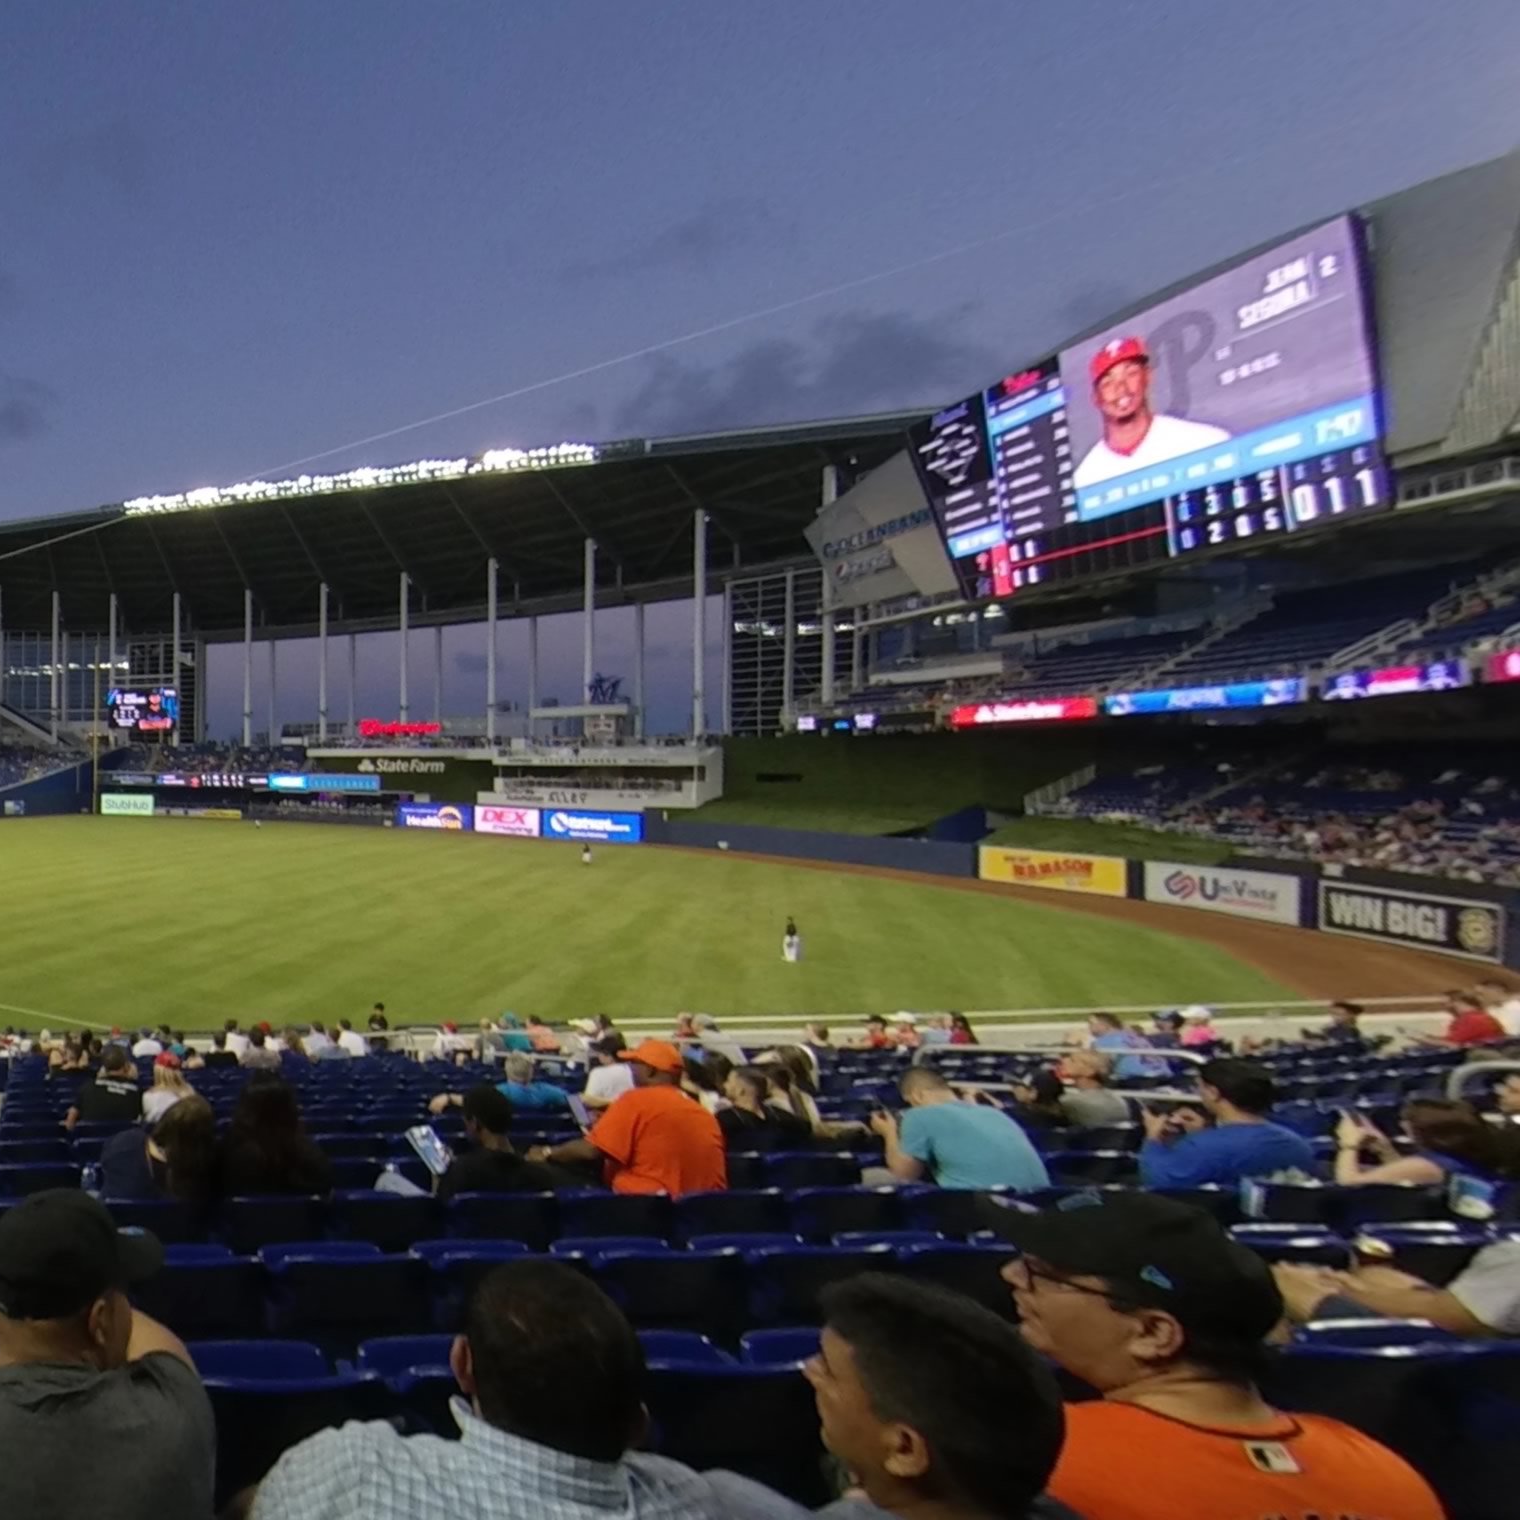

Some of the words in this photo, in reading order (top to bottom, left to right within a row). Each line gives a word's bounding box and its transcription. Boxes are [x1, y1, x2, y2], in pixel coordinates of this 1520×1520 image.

[1293, 484, 1318, 521] 0
[1324, 477, 1345, 514] 1
[1355, 468, 1376, 507] 1
[105, 799, 149, 811] StubHub
[481, 808, 528, 825] DEX
[1330, 892, 1384, 931] WIN
[1387, 901, 1448, 941] BIG!
